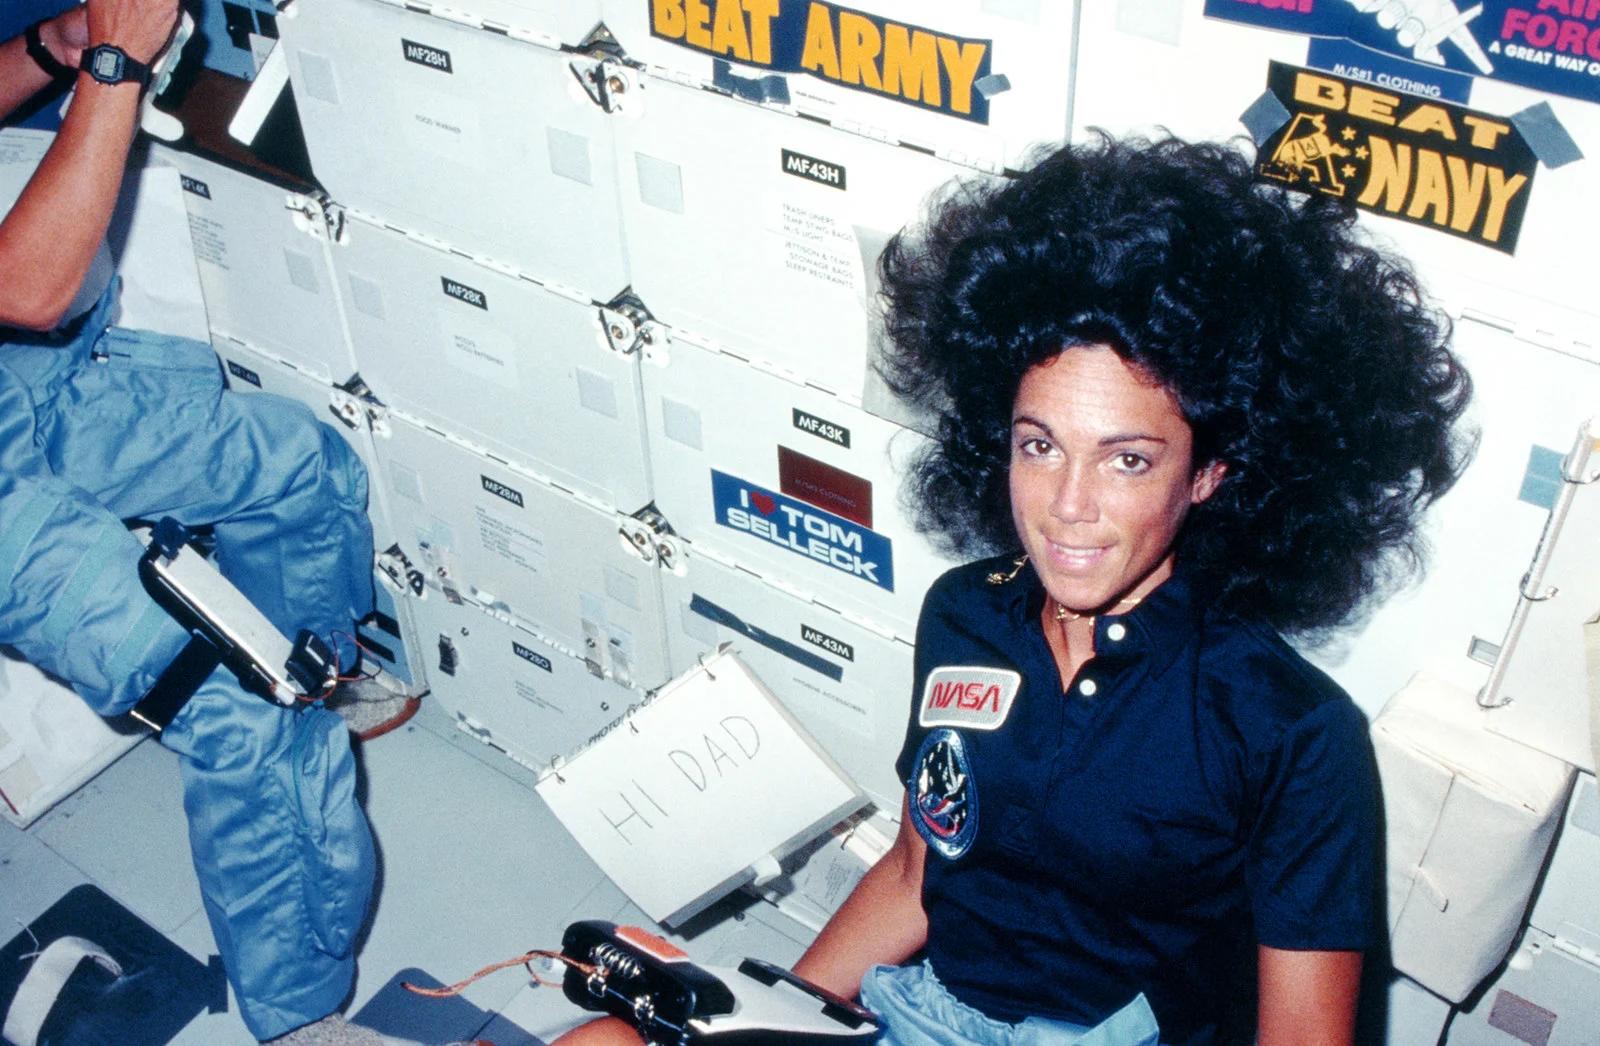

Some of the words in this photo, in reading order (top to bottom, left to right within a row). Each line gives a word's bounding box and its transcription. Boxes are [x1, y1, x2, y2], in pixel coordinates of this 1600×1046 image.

[407, 45, 448, 68] MF28H
[653, 0, 780, 65] BEAT
[801, 2, 987, 115] ARMY
[1488, 40, 1501, 53] A
[1504, 44, 1553, 66] GREAT
[1555, 53, 1588, 73] WAY
[1377, 73, 1441, 98] CLOTHING
[1294, 72, 1510, 150] BEAT
[787, 155, 840, 184] MF43H
[1357, 135, 1527, 243] NAVY
[447, 282, 483, 306] MF28K
[798, 414, 844, 443] MF43K
[484, 479, 522, 505] MF28M
[740, 488, 749, 508] I
[780, 504, 863, 553] TOM
[727, 506, 879, 583] SELLECK
[804, 629, 850, 659] MF43M
[928, 681, 1000, 713] NASA
[599, 778, 669, 846] HI
[668, 715, 761, 792] DAD
